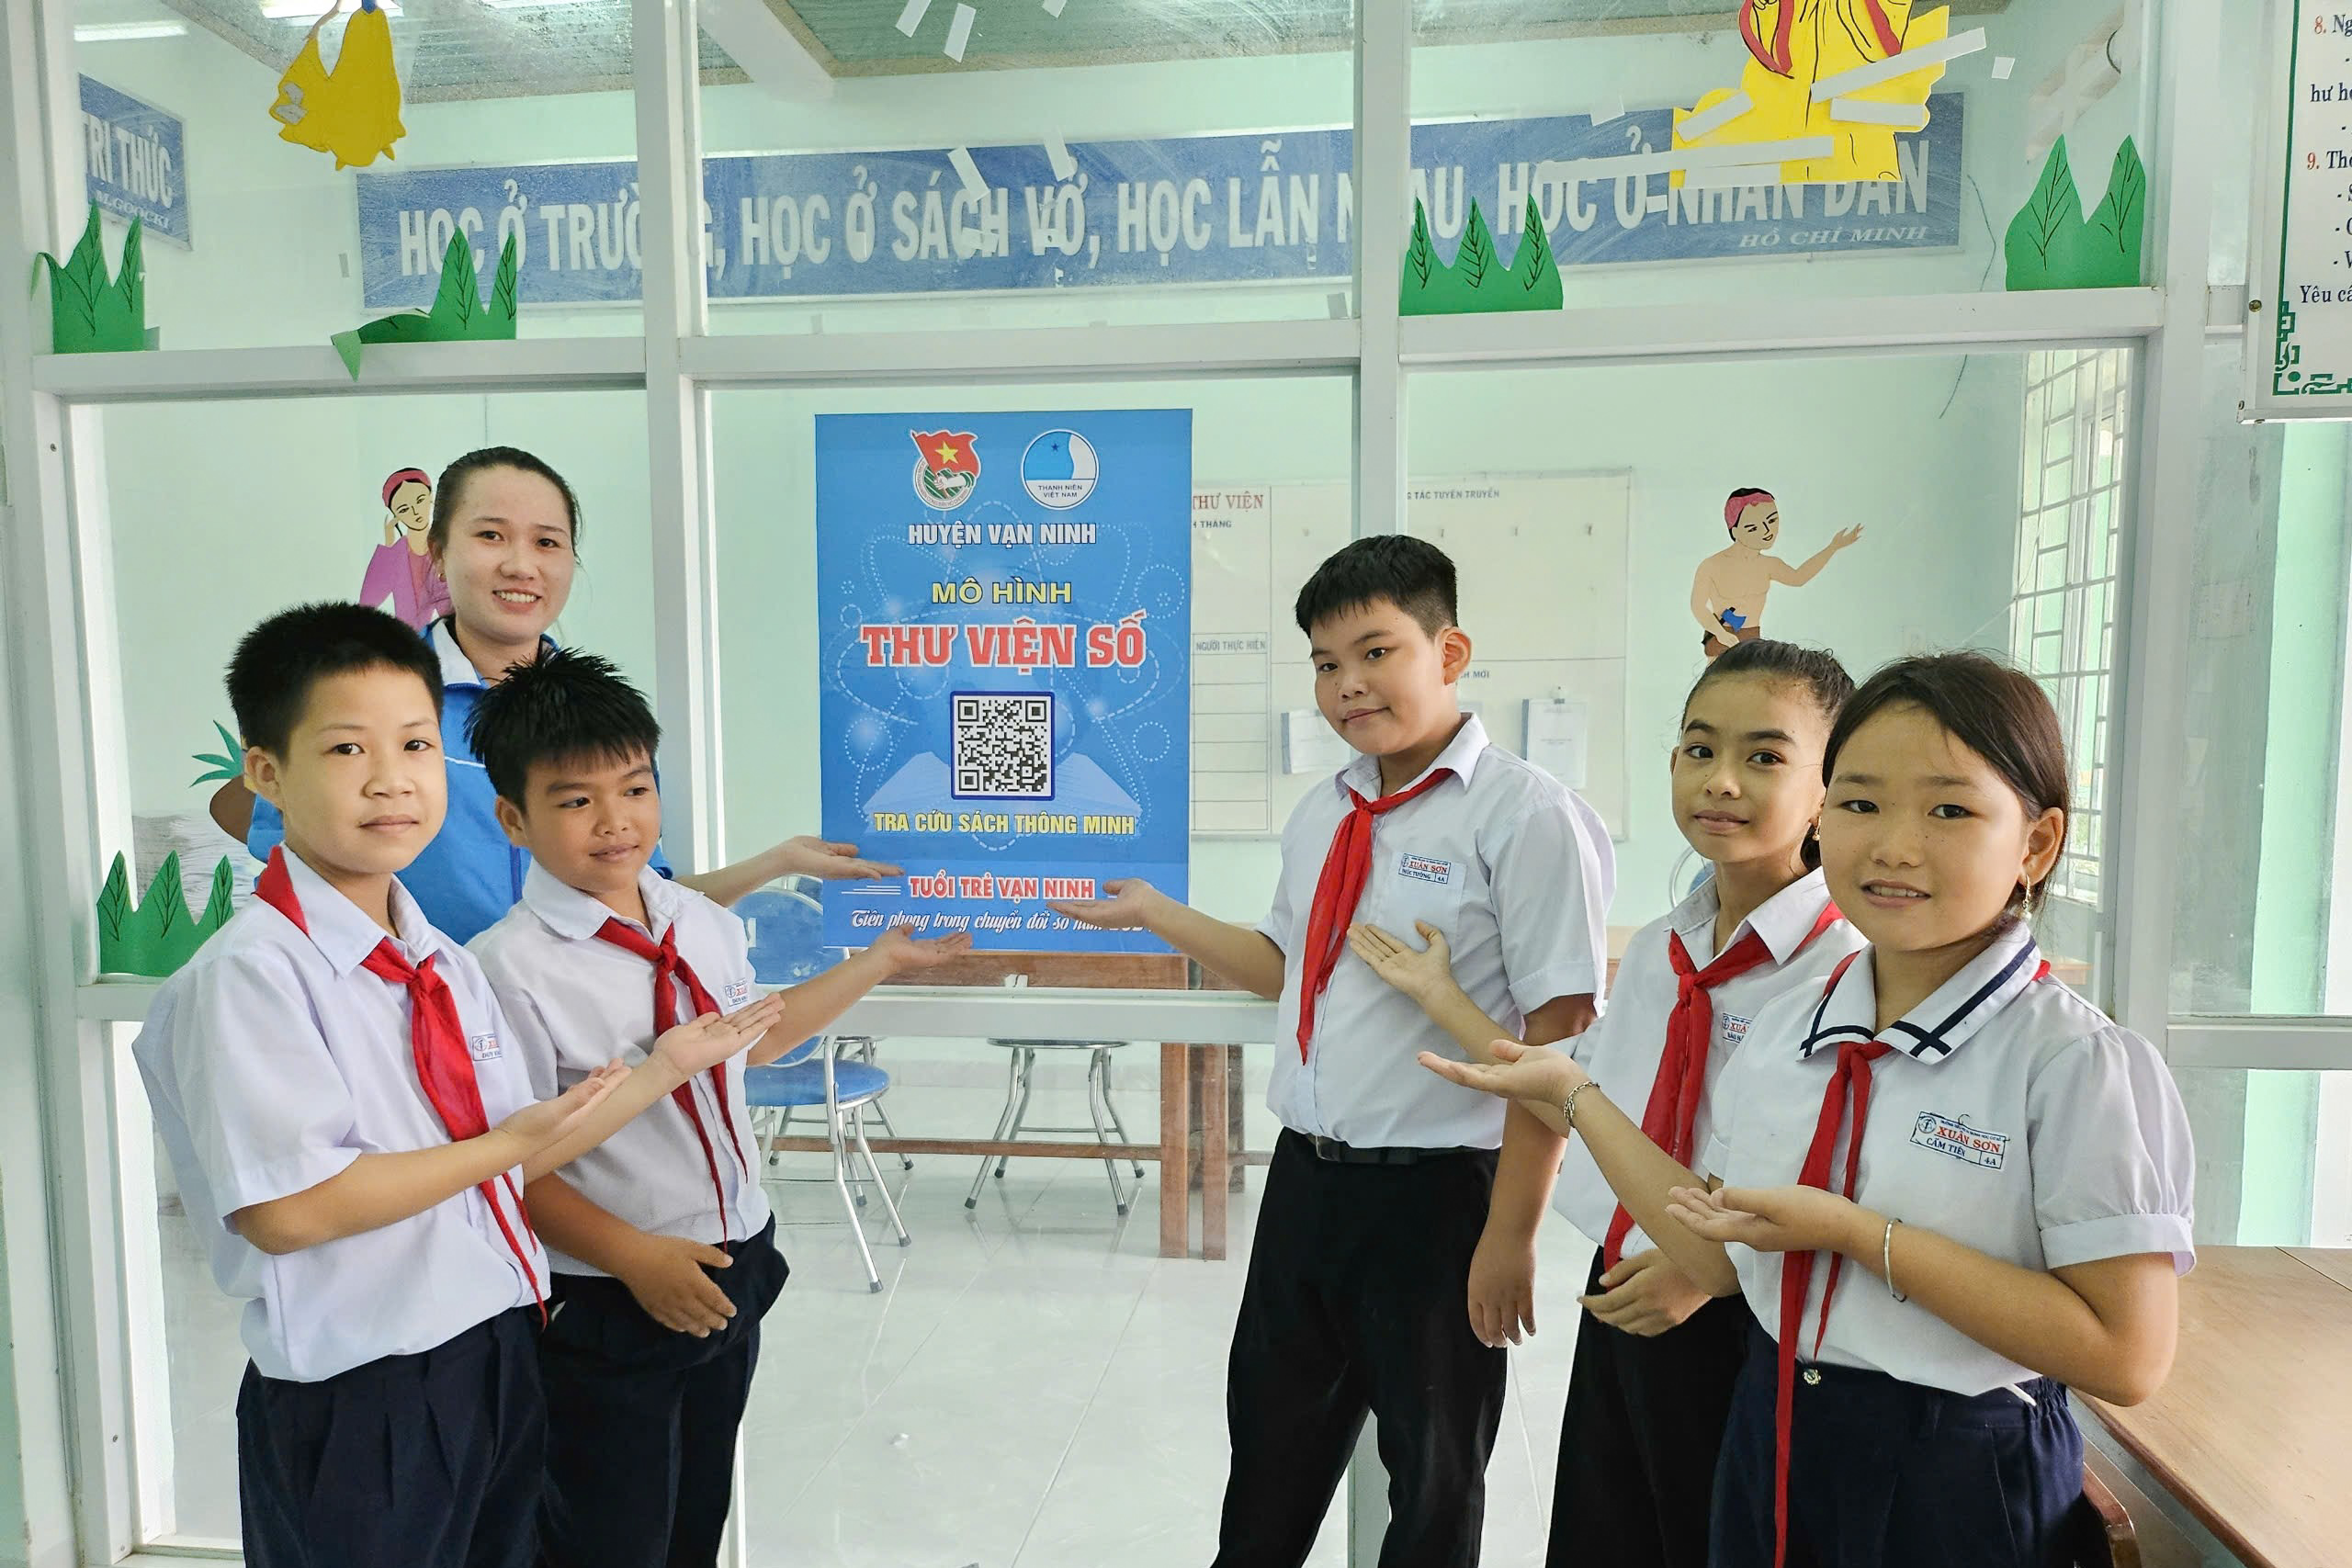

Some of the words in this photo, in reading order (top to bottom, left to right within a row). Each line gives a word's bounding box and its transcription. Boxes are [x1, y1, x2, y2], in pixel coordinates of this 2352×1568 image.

[2311, 84, 2334, 102] hư
[117, 125, 173, 209] THỨC
[2307, 152, 2320, 170] 9.
[741, 196, 831, 279] HỌC
[846, 166, 877, 264] Ở
[891, 170, 1009, 261] SÁCH
[1117, 179, 1212, 266] HỌC
[1229, 140, 1318, 248] LẪN
[1738, 228, 1781, 247] HỒ
[1792, 227, 1841, 244] CHÍ
[1850, 226, 1928, 243] MINH
[2300, 285, 2332, 303] Yêu
[1226, 491, 1264, 513] VIỆN
[909, 521, 981, 549] HUYỆN
[989, 524, 1035, 550] VẠN
[1039, 524, 1097, 544] NINH
[932, 577, 984, 604] MÔ
[992, 578, 1072, 604] HÌNH
[860, 625, 958, 667] THƯ
[966, 617, 1078, 675] VIỆN
[1087, 609, 1148, 668] SỐ
[874, 813, 909, 831] TRA
[915, 809, 953, 832] CỨU
[958, 810, 1010, 833] SÁCH
[1014, 811, 1078, 834] THÔNG
[1083, 816, 1135, 835] MINH
[909, 869, 956, 898] TUỔI
[959, 872, 994, 898] TRẺ
[996, 876, 1038, 904] VẠN
[1043, 878, 1095, 900] NINH
[851, 909, 885, 928] Tiên
[933, 911, 971, 933] trong
[974, 908, 1023, 934] chuyển
[1026, 909, 1051, 930] đổi
[1938, 1125, 1970, 1145] XUÂN
[1973, 1138, 2000, 1153] SƠN
[1984, 1156, 1996, 1166] 4A
